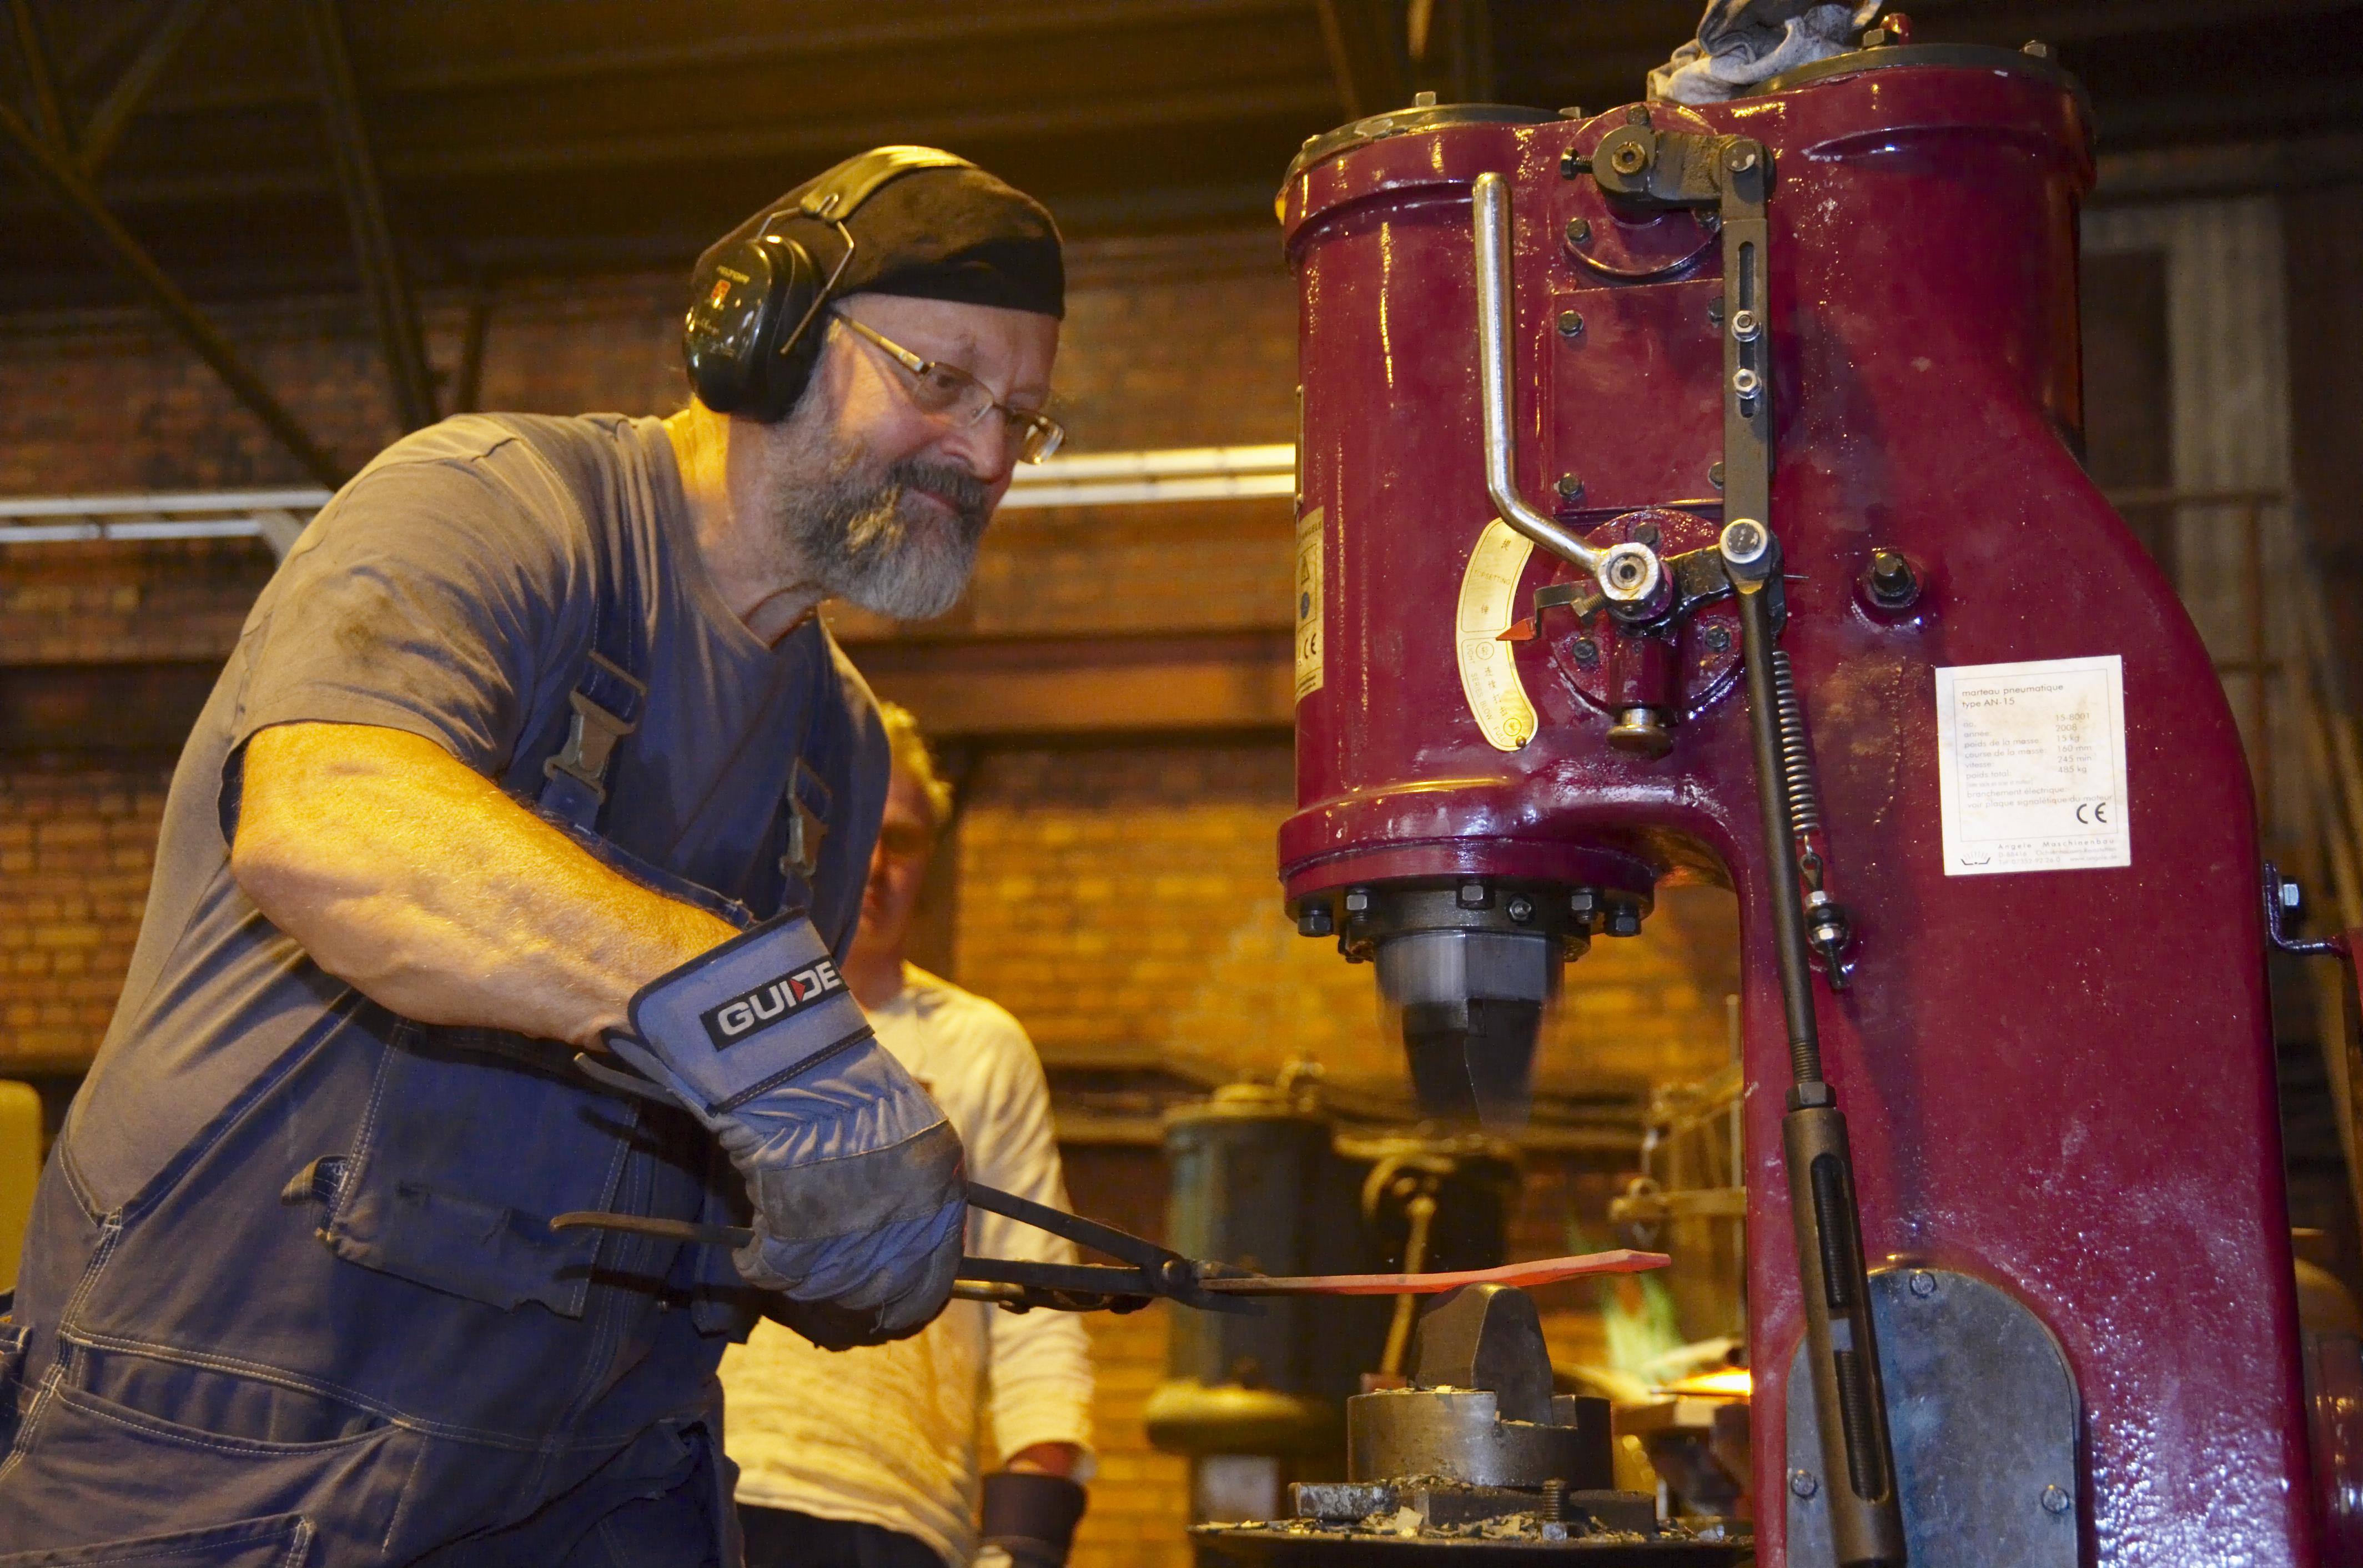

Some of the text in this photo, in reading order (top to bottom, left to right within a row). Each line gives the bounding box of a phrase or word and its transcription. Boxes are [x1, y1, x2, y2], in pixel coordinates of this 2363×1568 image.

[1473, 568, 1511, 586] TOPSETTING
[1466, 644, 1507, 743] LIGHT SERIES BLOW FULL
[1961, 684, 2064, 697] marteau pneumatique
[1962, 697, 2015, 709] type AN-15
[2055, 712, 2090, 722] 15-8001
[2055, 723, 2078, 732] 2008
[1964, 740, 1987, 748] poids
[1989, 738, 2000, 747] de
[2057, 733, 2080, 744] 15 kg
[1994, 748, 2005, 757] de
[2007, 748, 2015, 756] la
[2058, 755, 2074, 763] 245
[2058, 765, 2088, 774] 485 kg
[1966, 771, 1989, 780] poids
[1967, 788, 2022, 798] branchement
[1985, 798, 2014, 808] plaque
[2017, 796, 2068, 807] signalétique
[2069, 794, 2081, 802] du
[2083, 793, 2113, 801] moteur
[1998, 837, 2115, 851] Angele Maschinenbau
[718, 961, 841, 1036] GUIDE
